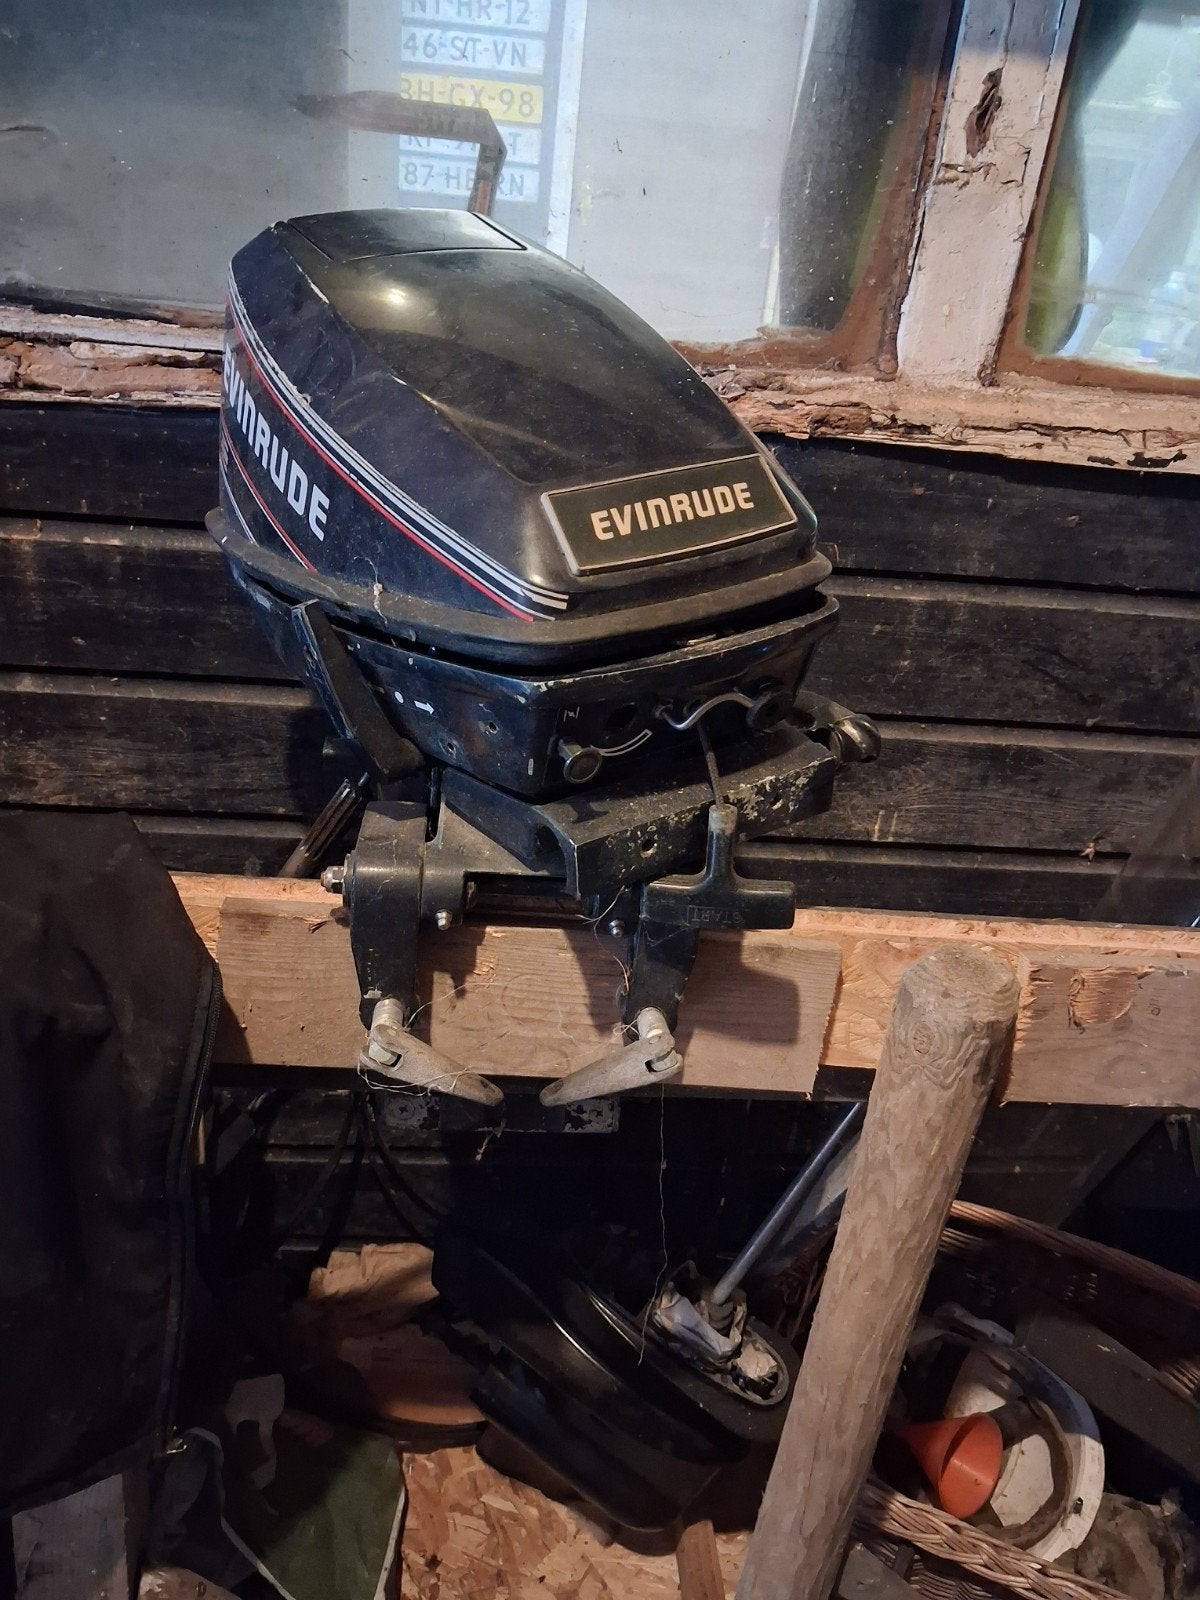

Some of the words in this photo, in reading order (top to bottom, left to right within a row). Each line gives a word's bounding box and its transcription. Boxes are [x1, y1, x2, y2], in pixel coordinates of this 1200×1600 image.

[403, 32, 526, 67] 46-ST-VN
[223, 343, 330, 541] EVINRUDE
[590, 482, 754, 541] EVINRUDE
[691, 908, 743, 924] START
